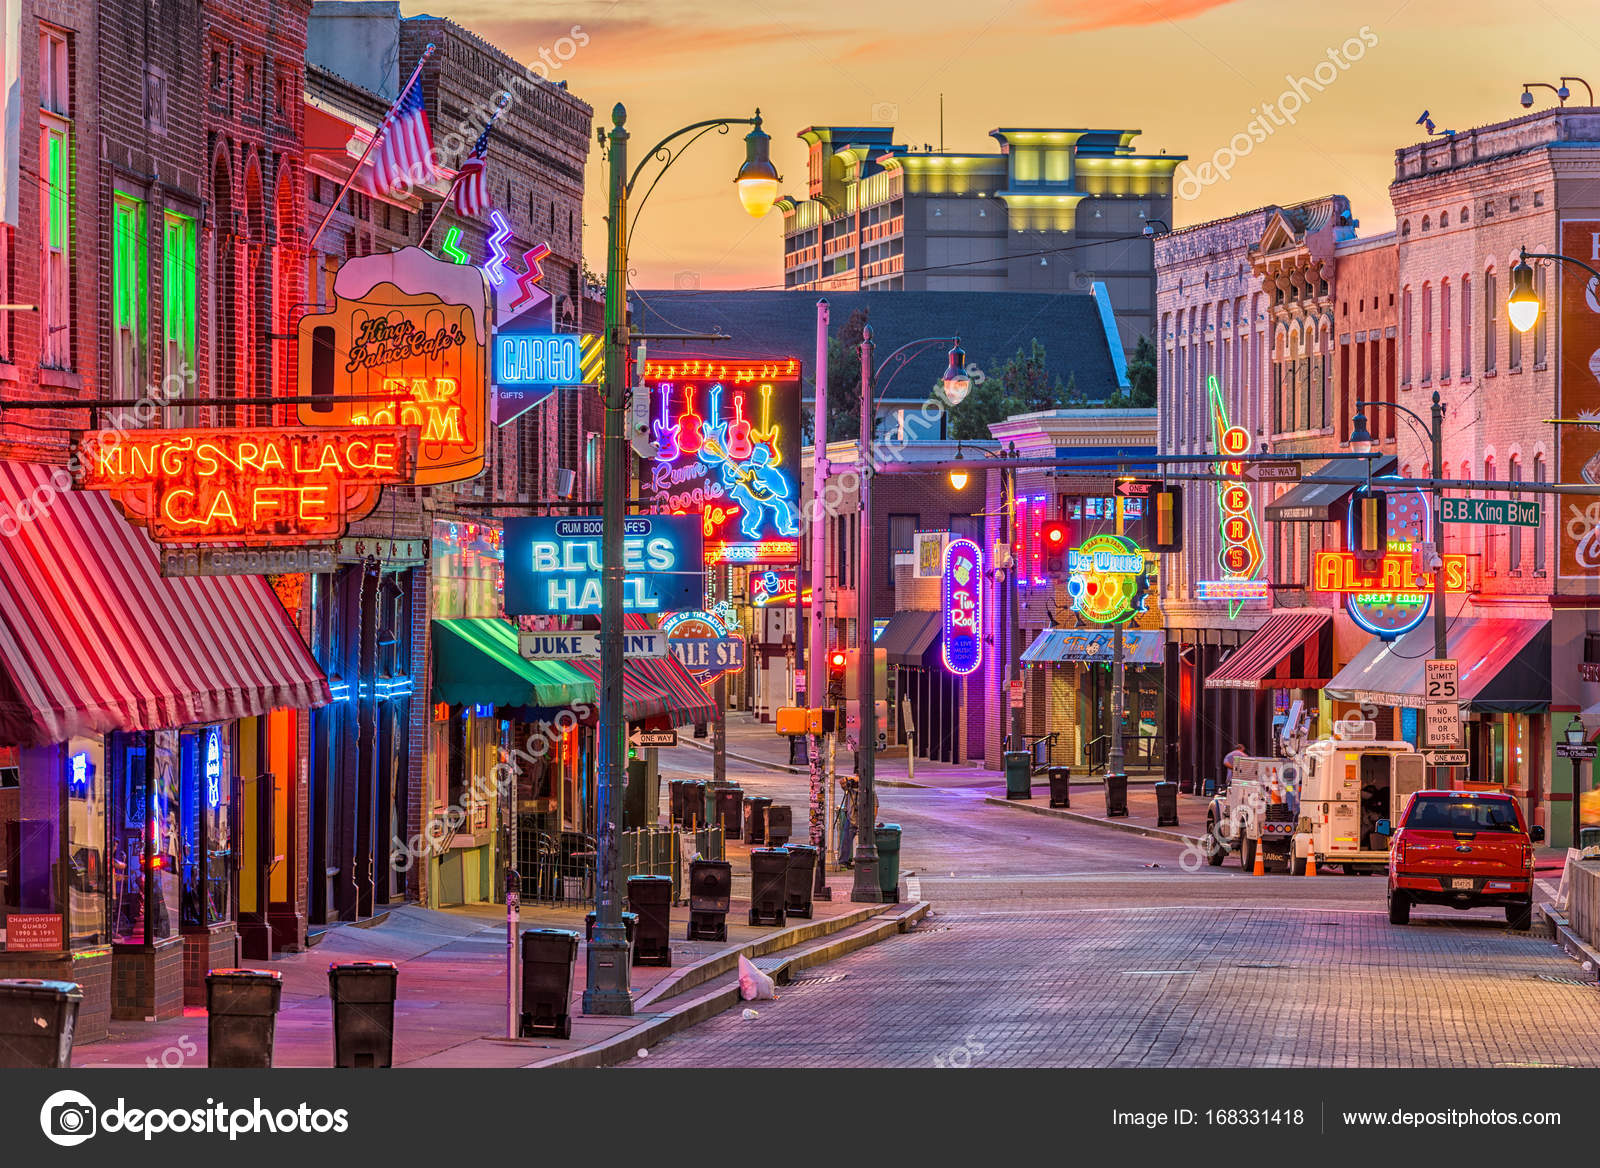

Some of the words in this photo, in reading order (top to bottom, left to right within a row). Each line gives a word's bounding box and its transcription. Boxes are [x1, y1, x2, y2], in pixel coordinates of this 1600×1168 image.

[345, 343, 411, 373] Palace
[409, 323, 466, 361] Cafe's
[502, 339, 575, 381] CARGO
[1258, 468, 1276, 477] ONE
[1278, 466, 1295, 476] WAY
[165, 486, 328, 527] CAFE
[1443, 500, 1472, 519] B.B.
[1475, 502, 1503, 523] King
[1507, 503, 1538, 524] Blvd.
[562, 522, 582, 533] RUM
[1388, 542, 1412, 553] MUS
[953, 591, 975, 610] Tin
[680, 612, 690, 620] OF
[951, 608, 977, 634] Roof
[529, 637, 582, 655] JUKE
[716, 641, 742, 666] ST.
[1427, 664, 1456, 672] SPEED
[1428, 681, 1456, 697] 25
[1434, 754, 1448, 762] ONE
